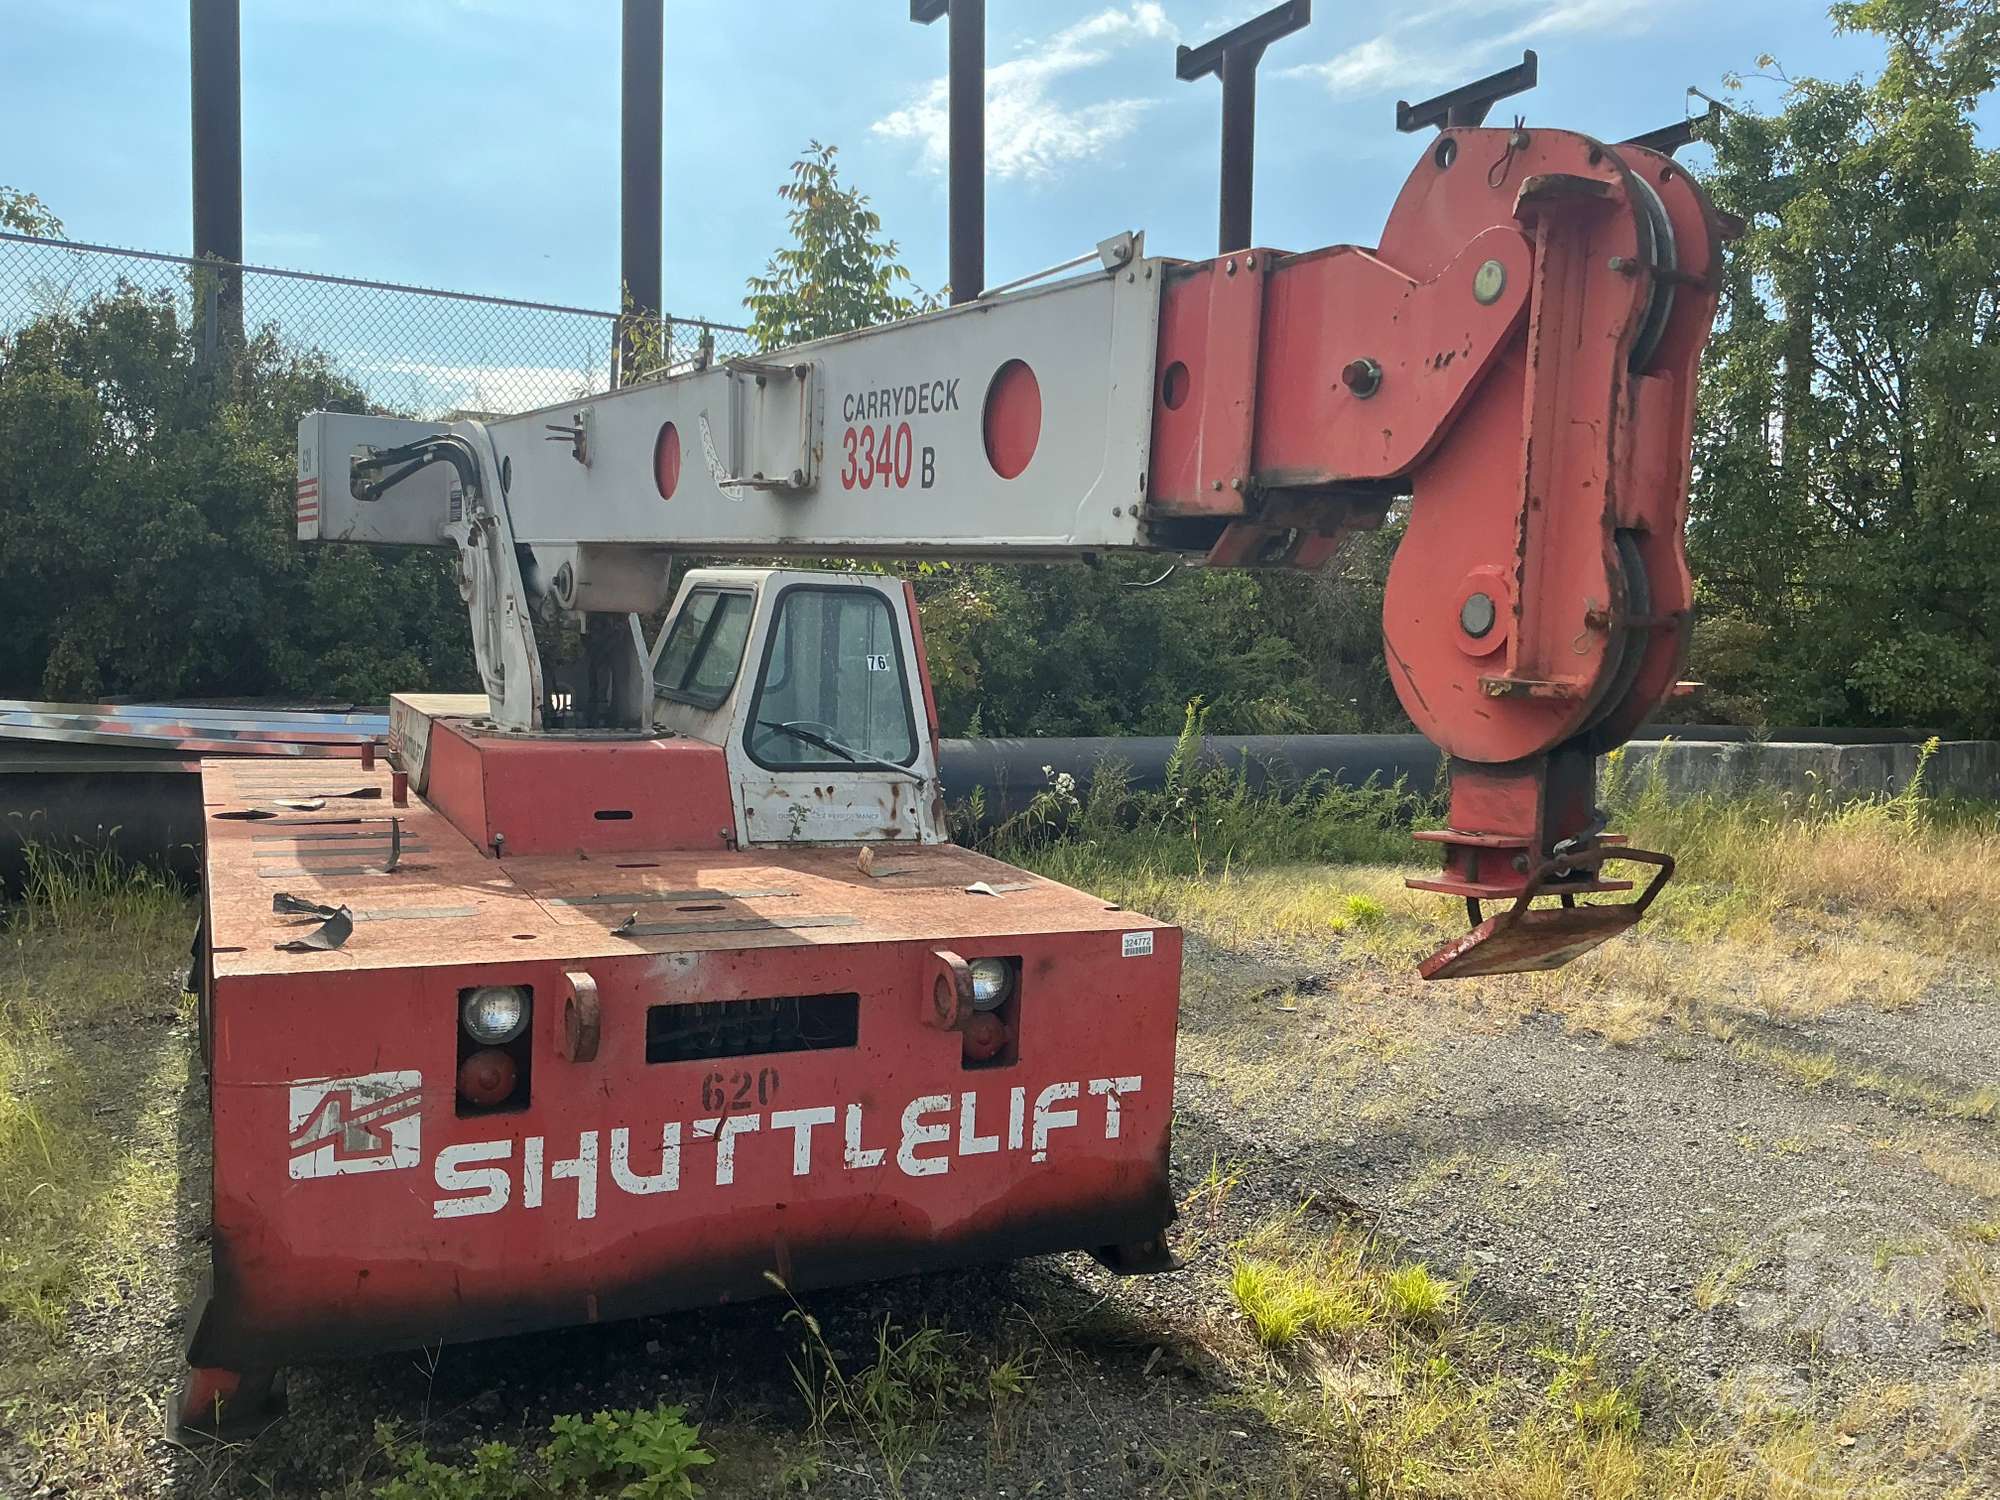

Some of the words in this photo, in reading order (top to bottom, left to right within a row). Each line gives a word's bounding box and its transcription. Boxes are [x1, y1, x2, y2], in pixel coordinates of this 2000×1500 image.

[843, 378, 960, 423] CARRYDECK
[841, 421, 913, 490] 3340
[921, 446, 936, 489] B
[867, 655, 886, 670] 76
[1124, 936, 1151, 948] 324772
[702, 1066, 780, 1111] 620
[433, 1076, 1143, 1220] SHUTTLELIFT
